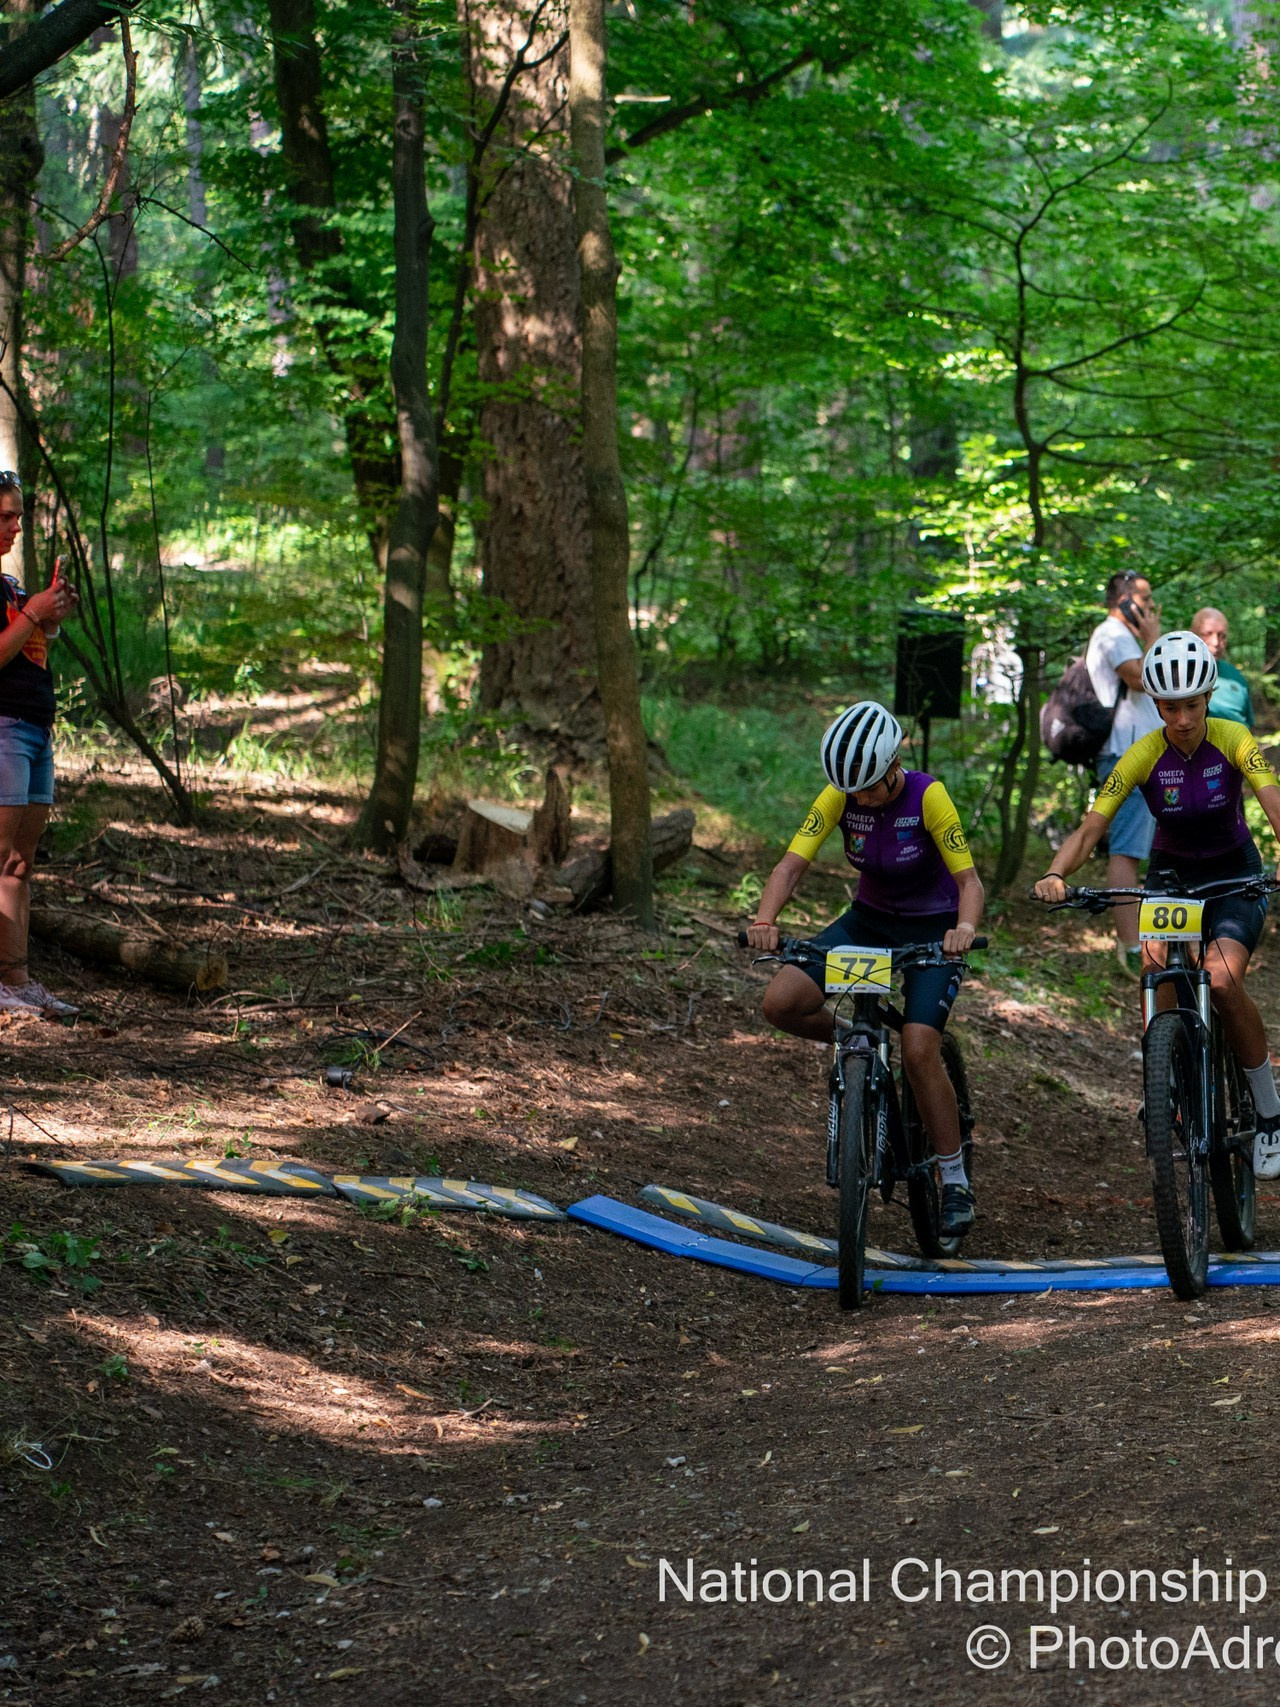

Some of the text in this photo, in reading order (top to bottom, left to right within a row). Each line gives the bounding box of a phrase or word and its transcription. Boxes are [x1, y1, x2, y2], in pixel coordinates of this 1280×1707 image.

[1158, 769, 1185, 779] ОМЕГА
[1159, 776, 1184, 786] ТИЙМ
[846, 812, 875, 823] ОМЕГА
[846, 820, 874, 832] ТИЙМ
[1152, 906, 1188, 930] 80
[840, 957, 877, 981] 77
